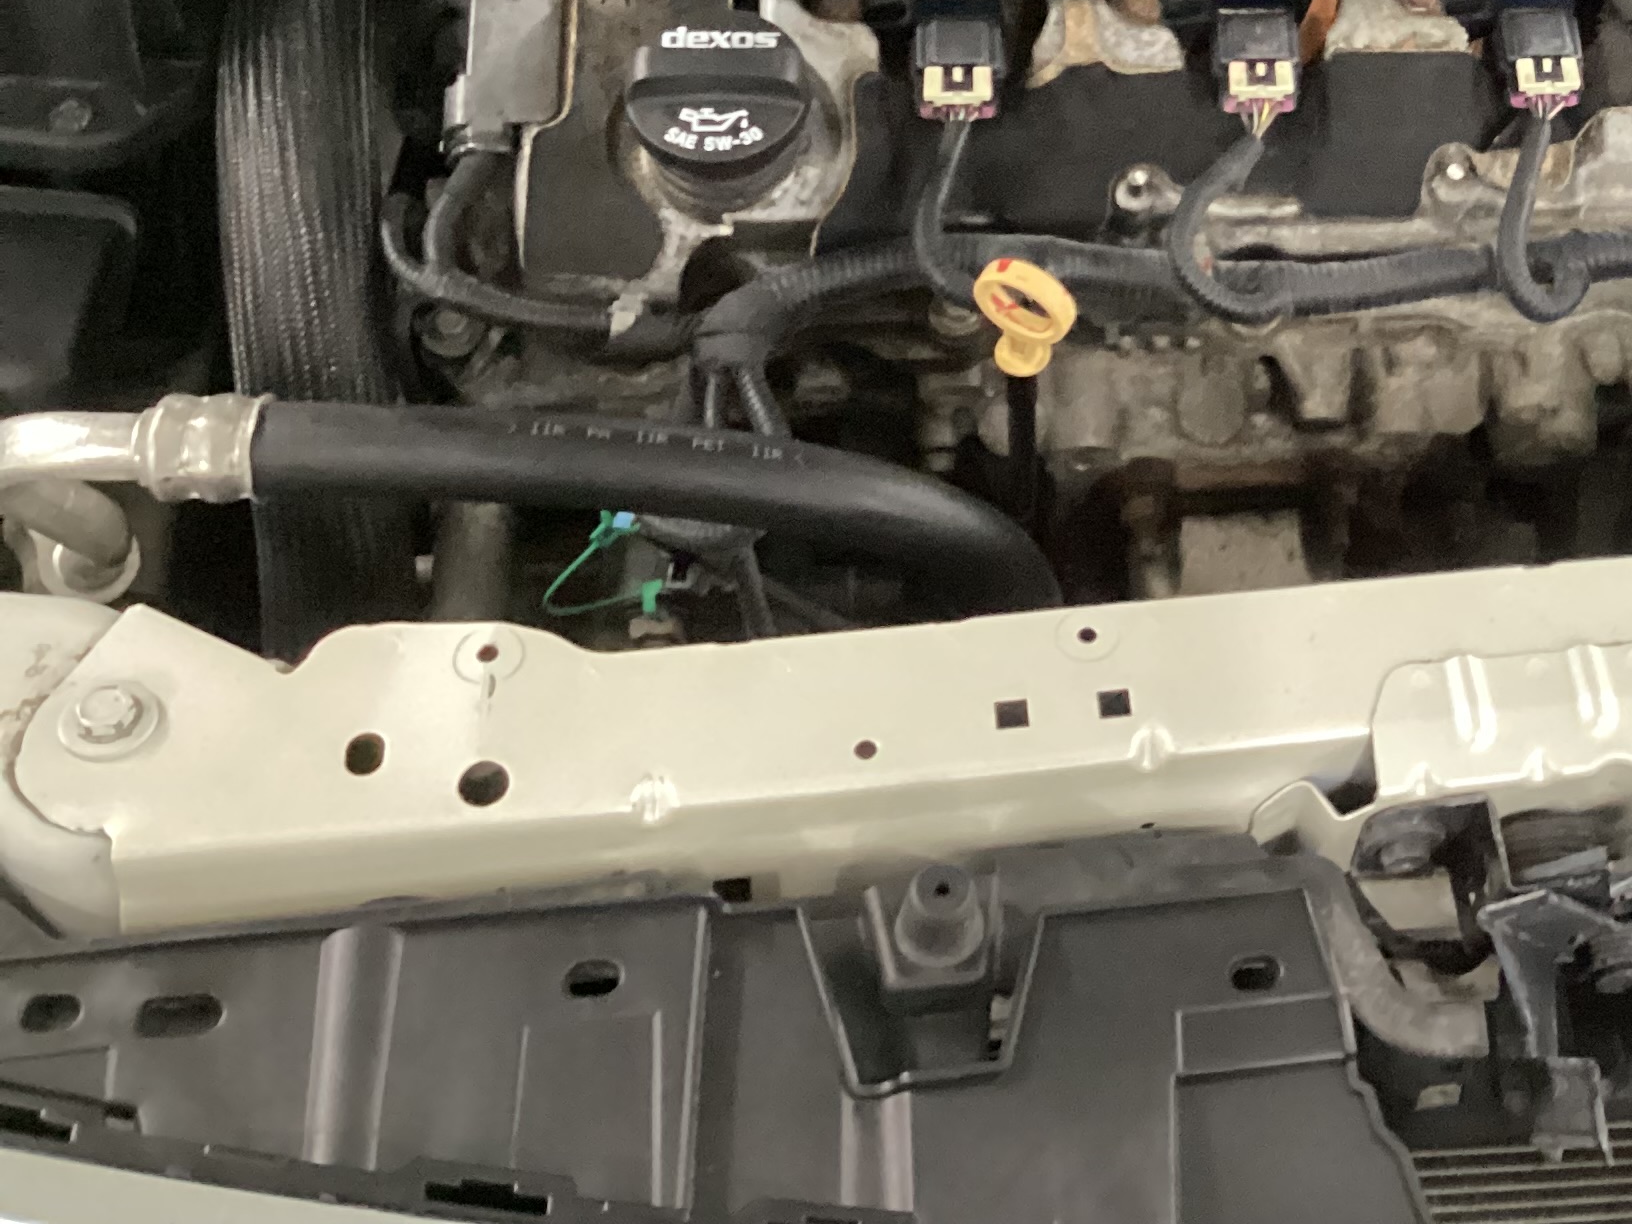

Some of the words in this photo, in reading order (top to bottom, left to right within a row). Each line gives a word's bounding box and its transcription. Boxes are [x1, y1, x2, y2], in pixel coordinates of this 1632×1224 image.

[661, 26, 782, 49] dexos
[664, 126, 698, 151] SAE
[703, 126, 765, 153] 5W-30
